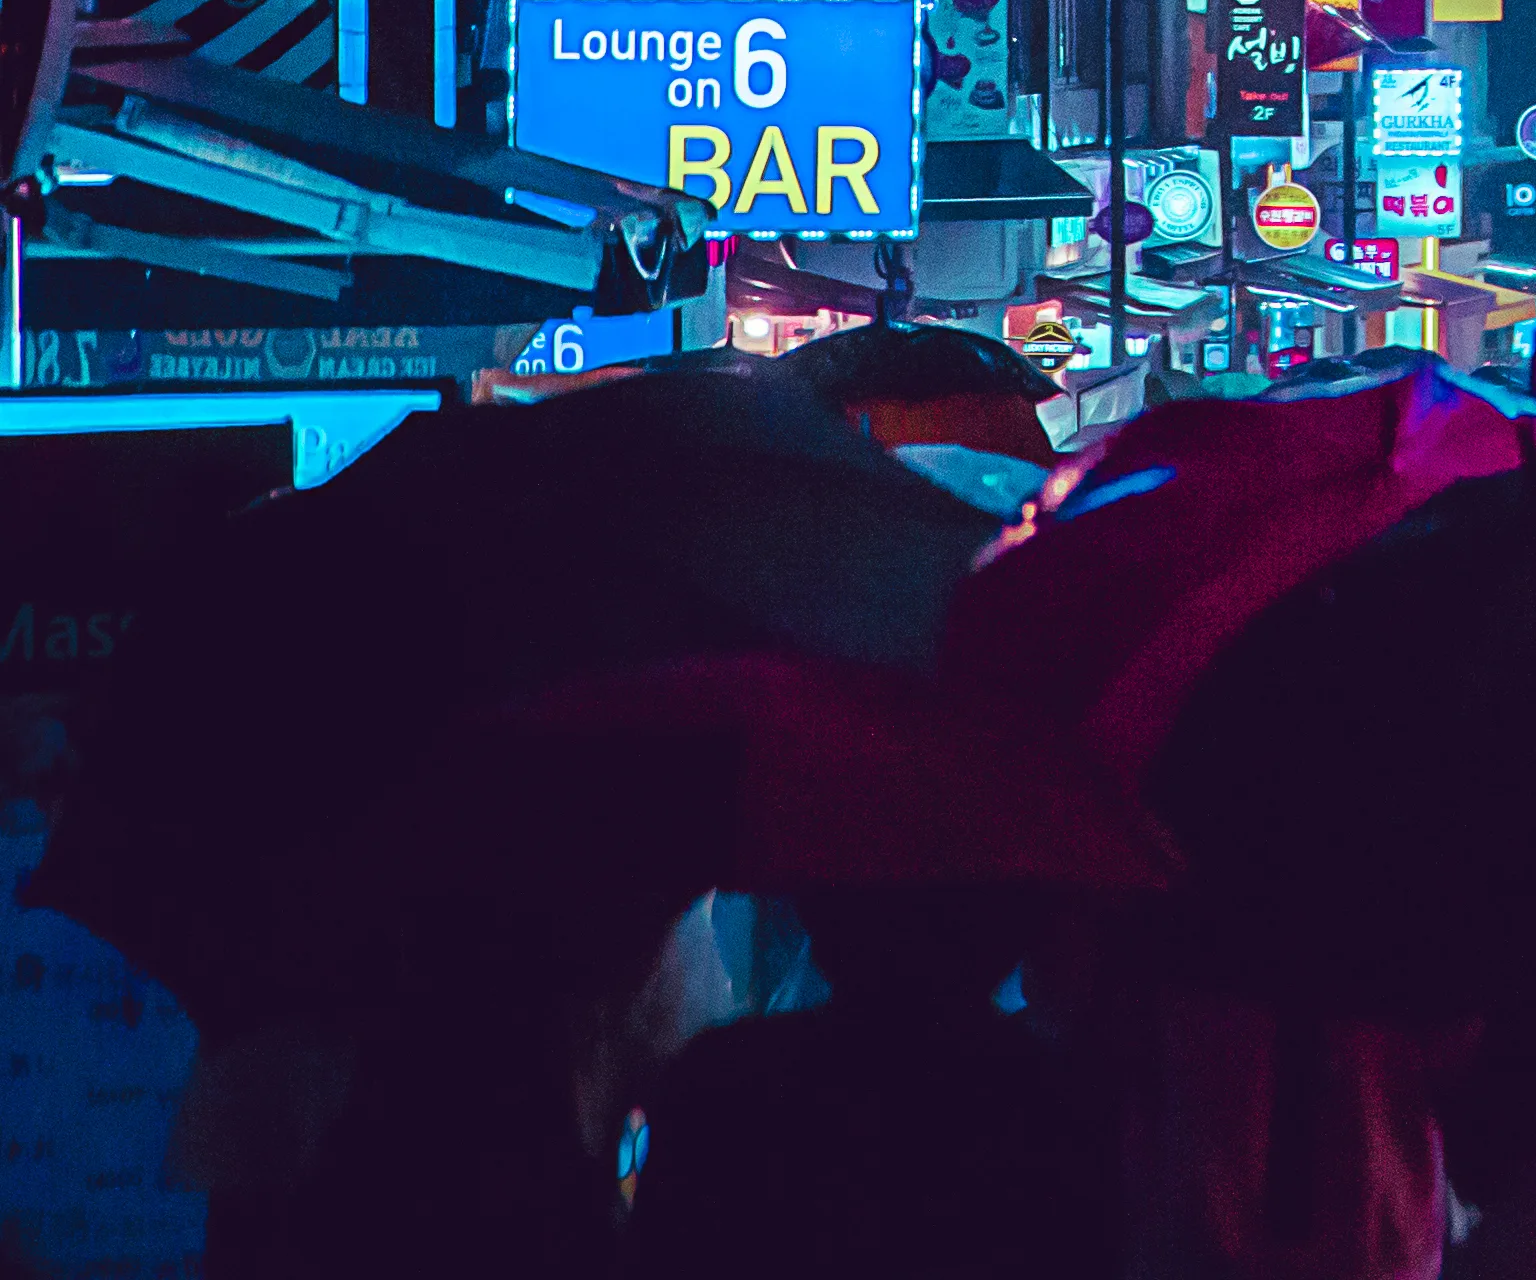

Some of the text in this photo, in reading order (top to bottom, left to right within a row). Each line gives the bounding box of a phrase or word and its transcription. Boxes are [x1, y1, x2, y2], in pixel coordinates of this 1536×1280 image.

[552, 18, 722, 70] Lounge
[732, 16, 788, 109] 6
[667, 77, 721, 109] on
[1252, 105, 1276, 121] 2F
[1380, 115, 1454, 130] GURKHA
[667, 123, 882, 215] BAR
